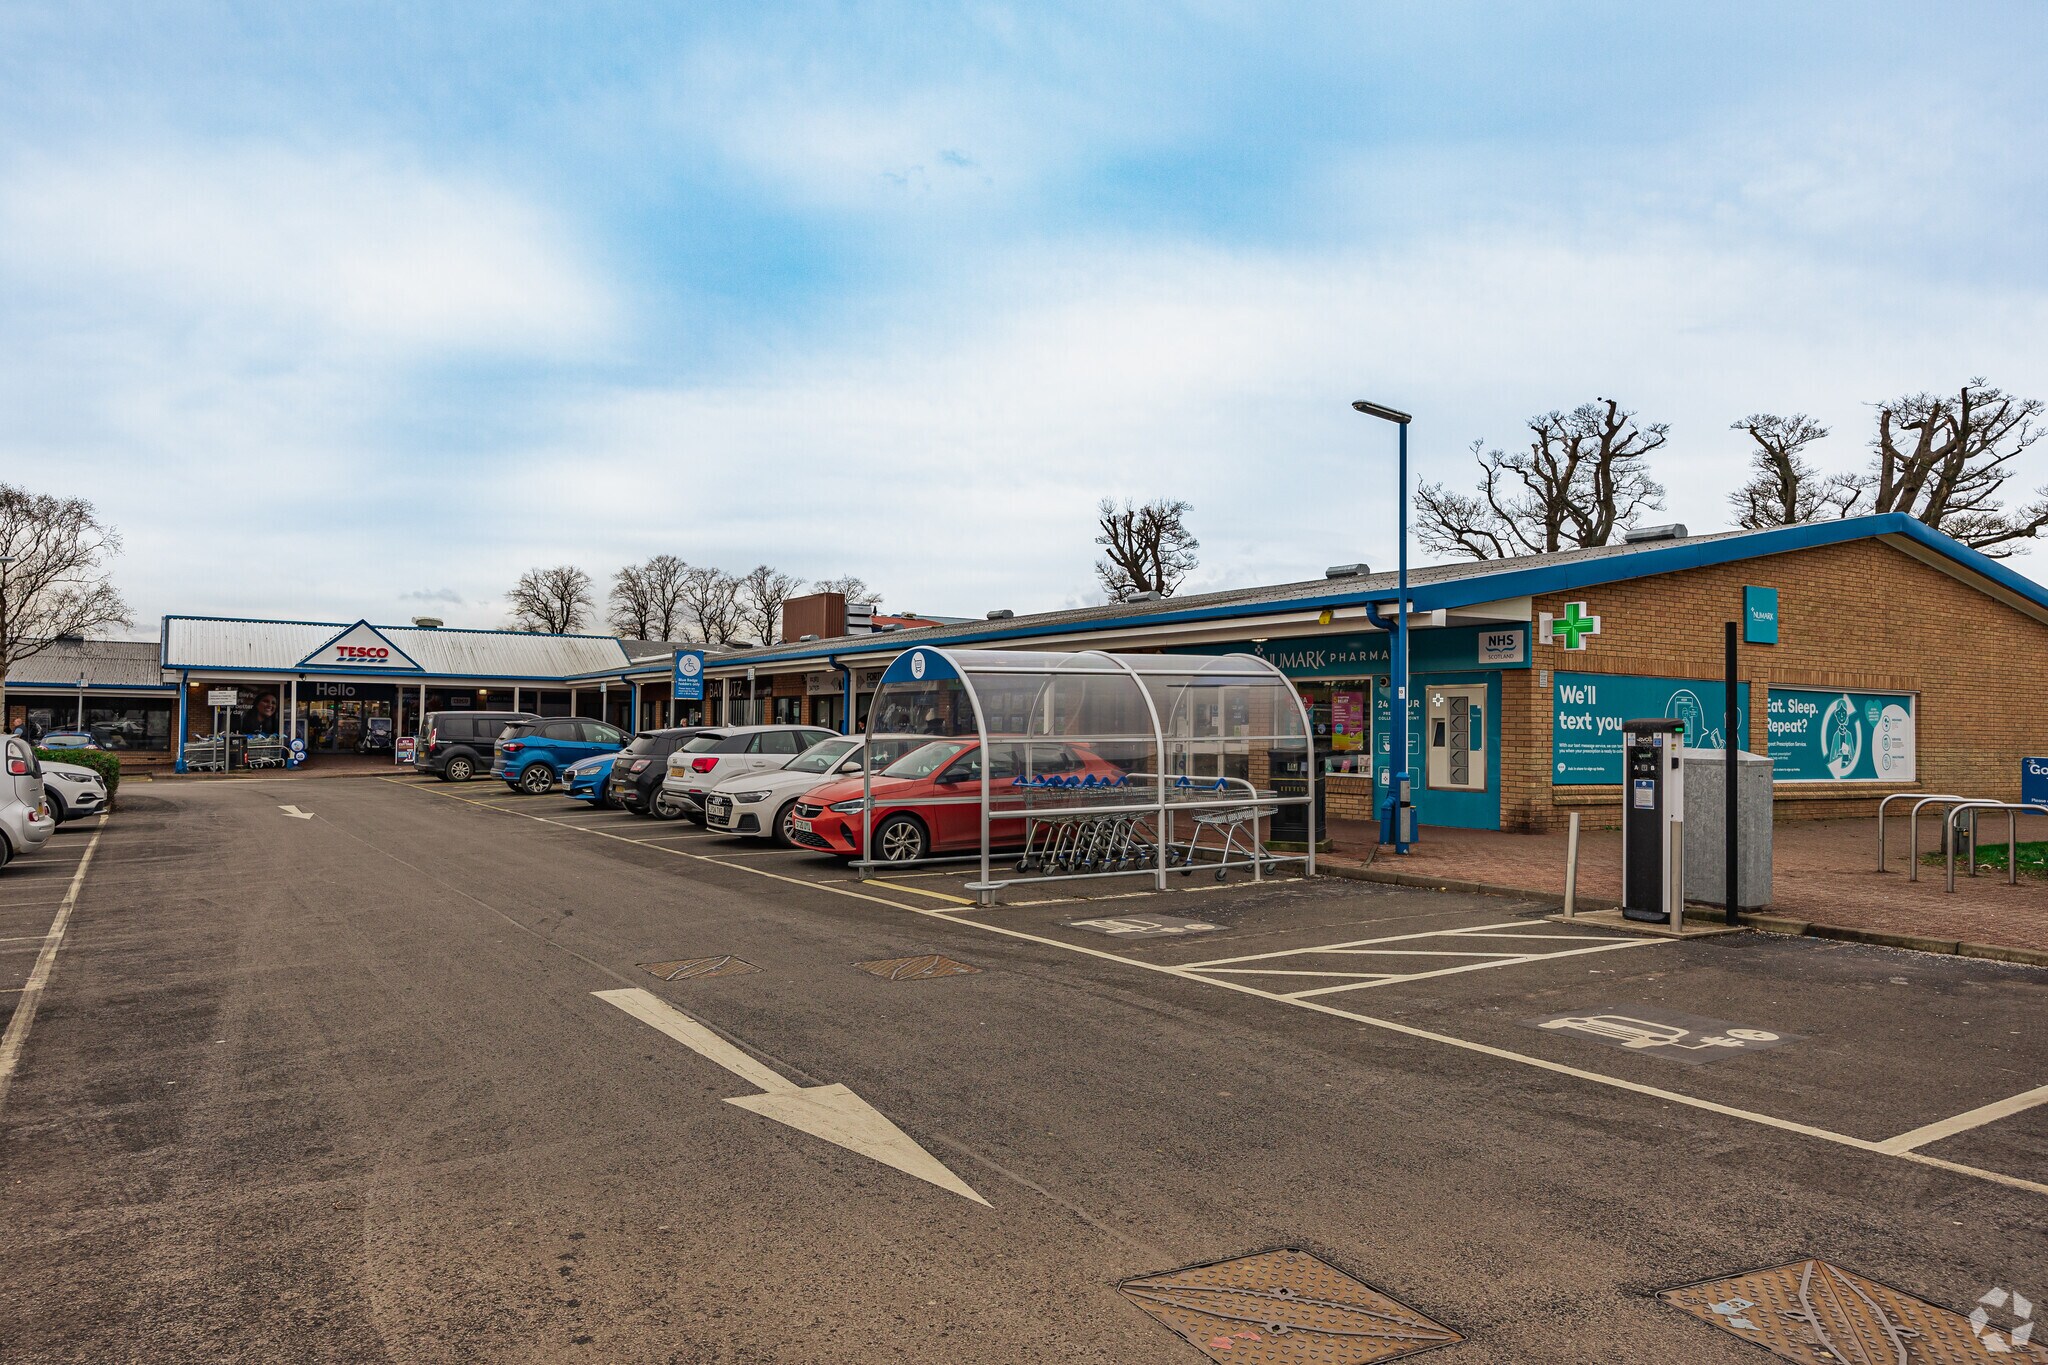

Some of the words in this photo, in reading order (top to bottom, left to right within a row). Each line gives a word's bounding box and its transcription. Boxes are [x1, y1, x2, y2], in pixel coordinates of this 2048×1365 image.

[1488, 634, 1514, 647] NHS
[337, 646, 389, 658] TESCO
[1330, 650, 1390, 662] PHARMA
[316, 683, 356, 696] Hello
[1560, 684, 1596, 705] We'll
[1788, 698, 1819, 718] Sleep.
[1559, 711, 1592, 730] text
[1596, 716, 1623, 736] you
